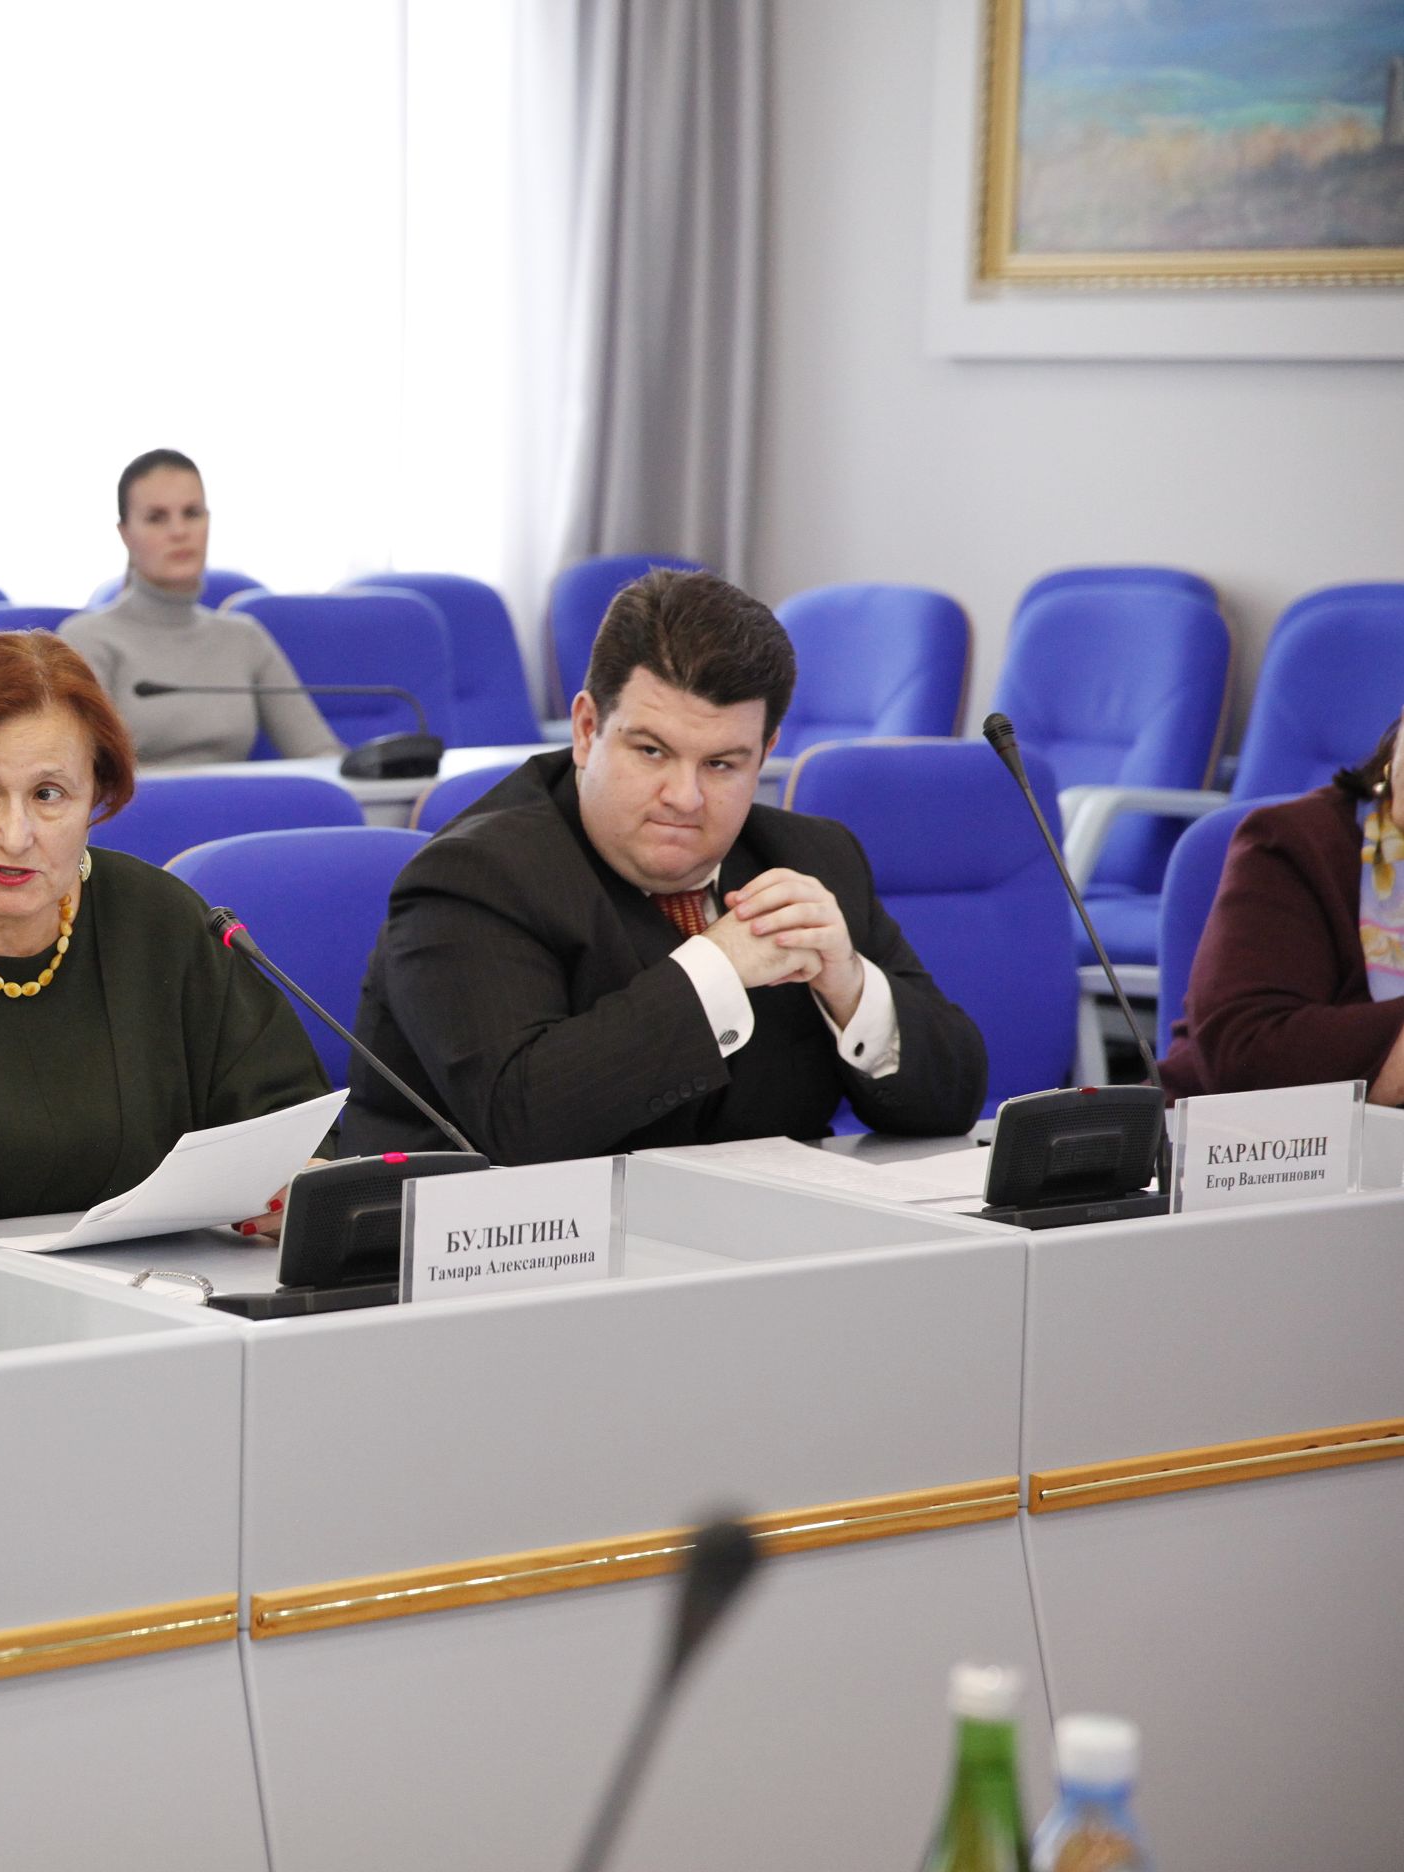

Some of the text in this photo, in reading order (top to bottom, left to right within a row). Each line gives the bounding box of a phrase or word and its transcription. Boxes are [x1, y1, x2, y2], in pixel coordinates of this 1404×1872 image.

[1207, 1136, 1329, 1165] КАРАГОДИН
[1206, 1169, 1325, 1191] Егор Валентинович
[446, 1217, 580, 1254] БУЛЫГИНА
[427, 1249, 596, 1282] Тамара Александровна
